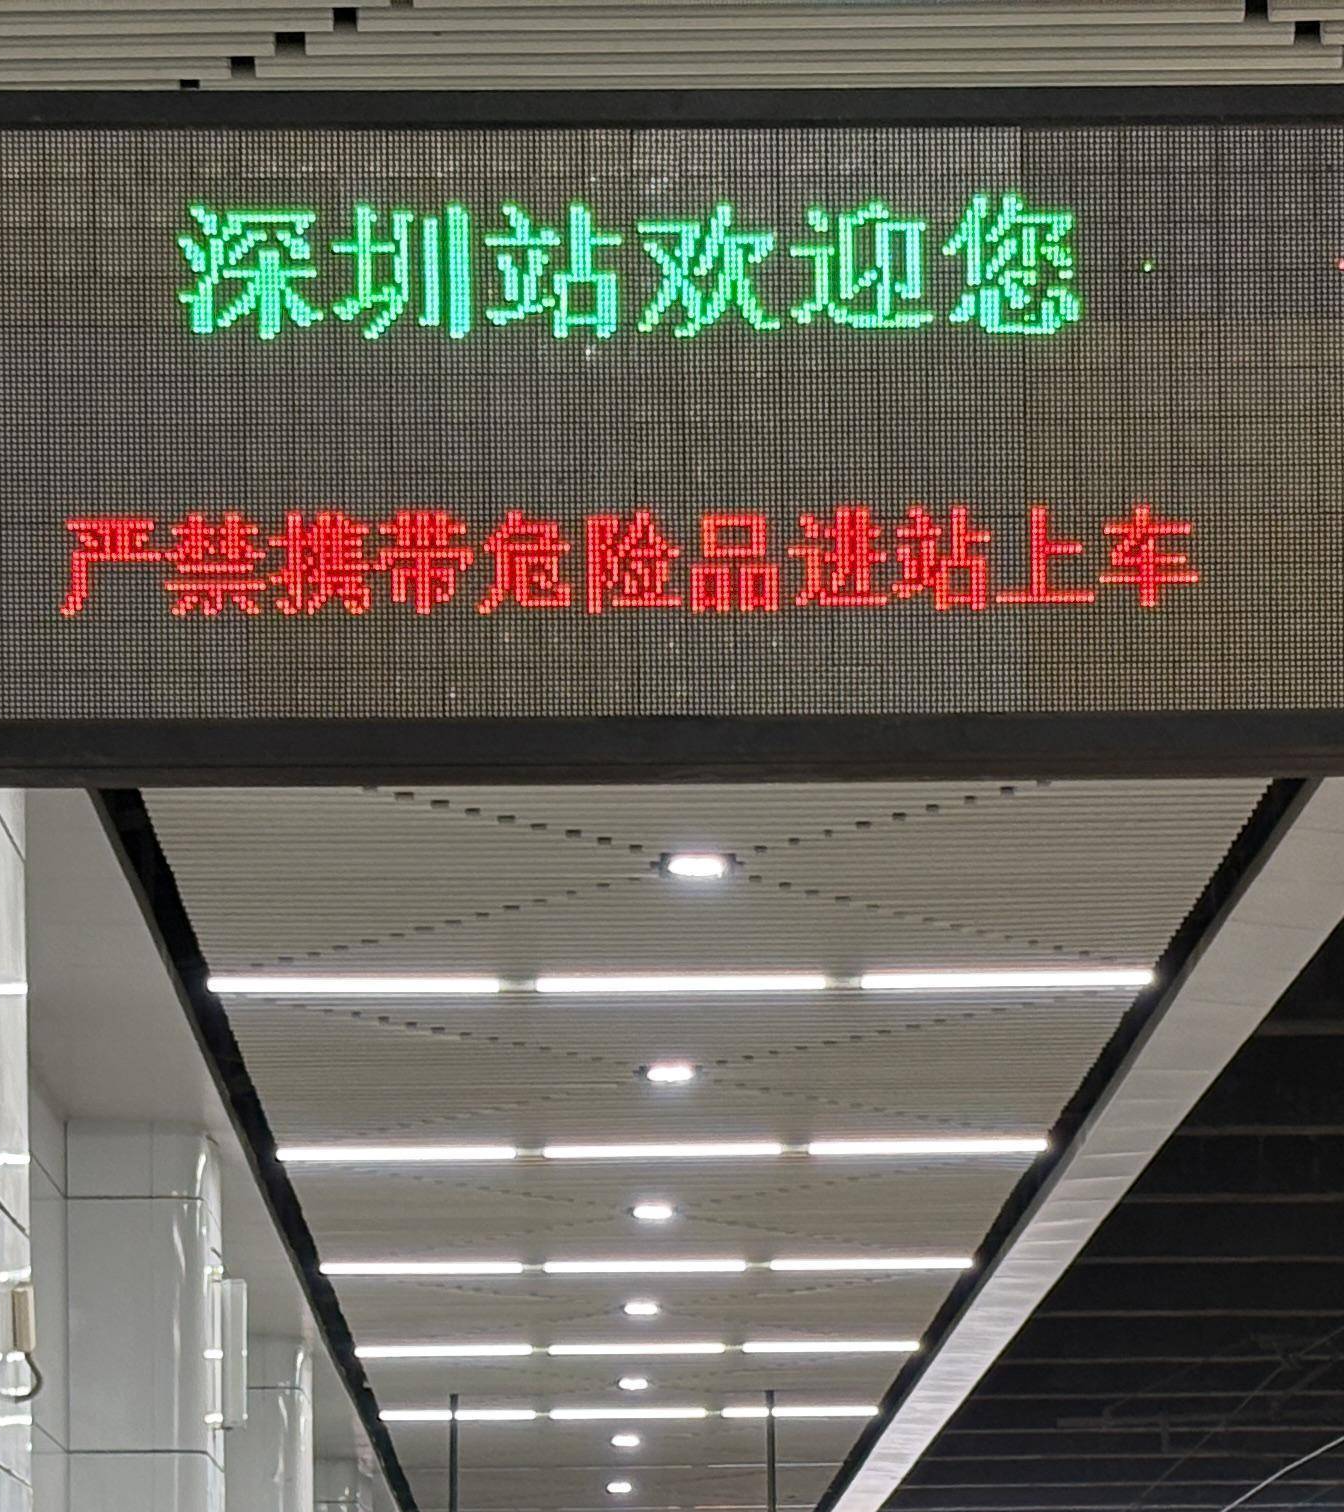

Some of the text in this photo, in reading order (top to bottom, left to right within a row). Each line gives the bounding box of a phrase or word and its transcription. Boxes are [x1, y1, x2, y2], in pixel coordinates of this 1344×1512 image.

[176, 190, 1084, 339] 深圳站欢迎您
[59, 505, 1201, 617] 严禁携带危险品进站上车
